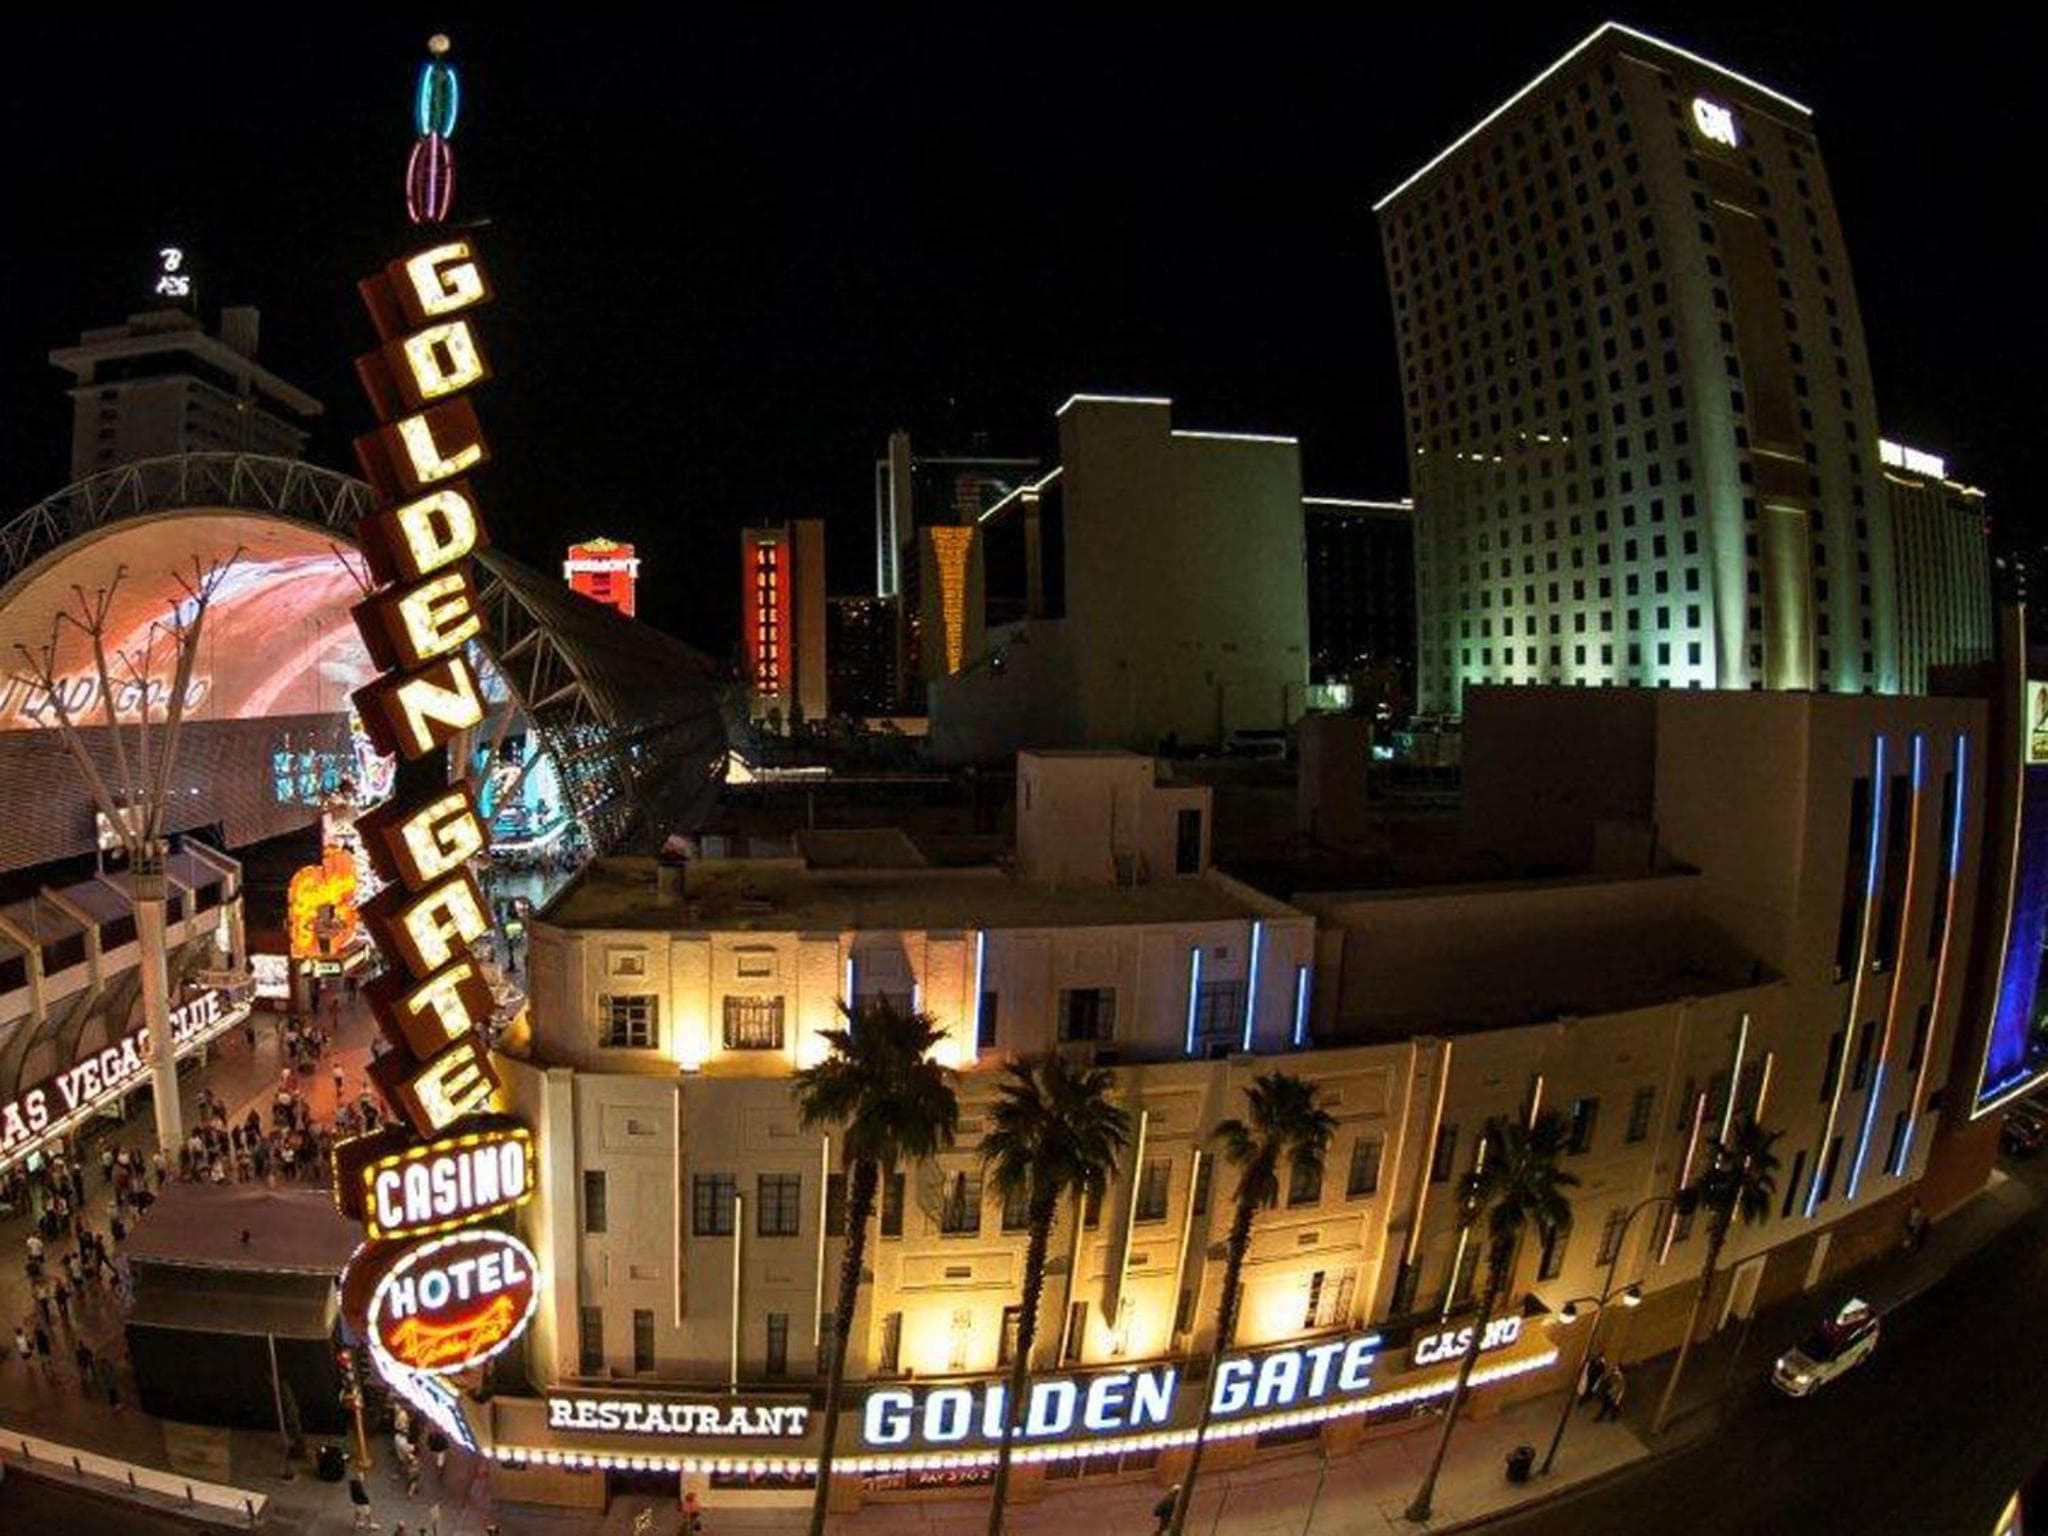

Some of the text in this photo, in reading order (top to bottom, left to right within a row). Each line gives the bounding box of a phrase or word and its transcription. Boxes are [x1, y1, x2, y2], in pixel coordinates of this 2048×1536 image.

[115, 678, 209, 713] GO-O
[398, 241, 493, 1130] GOLDEN GATE
[0, 1088, 49, 1150] AS
[375, 1140, 526, 1229] CASINO
[388, 1247, 527, 1319] HOTEL
[1413, 1316, 1522, 1366] CASNO
[548, 1398, 809, 1437] RESTAURANT
[862, 1334, 1383, 1446] GOLDEN GATE
